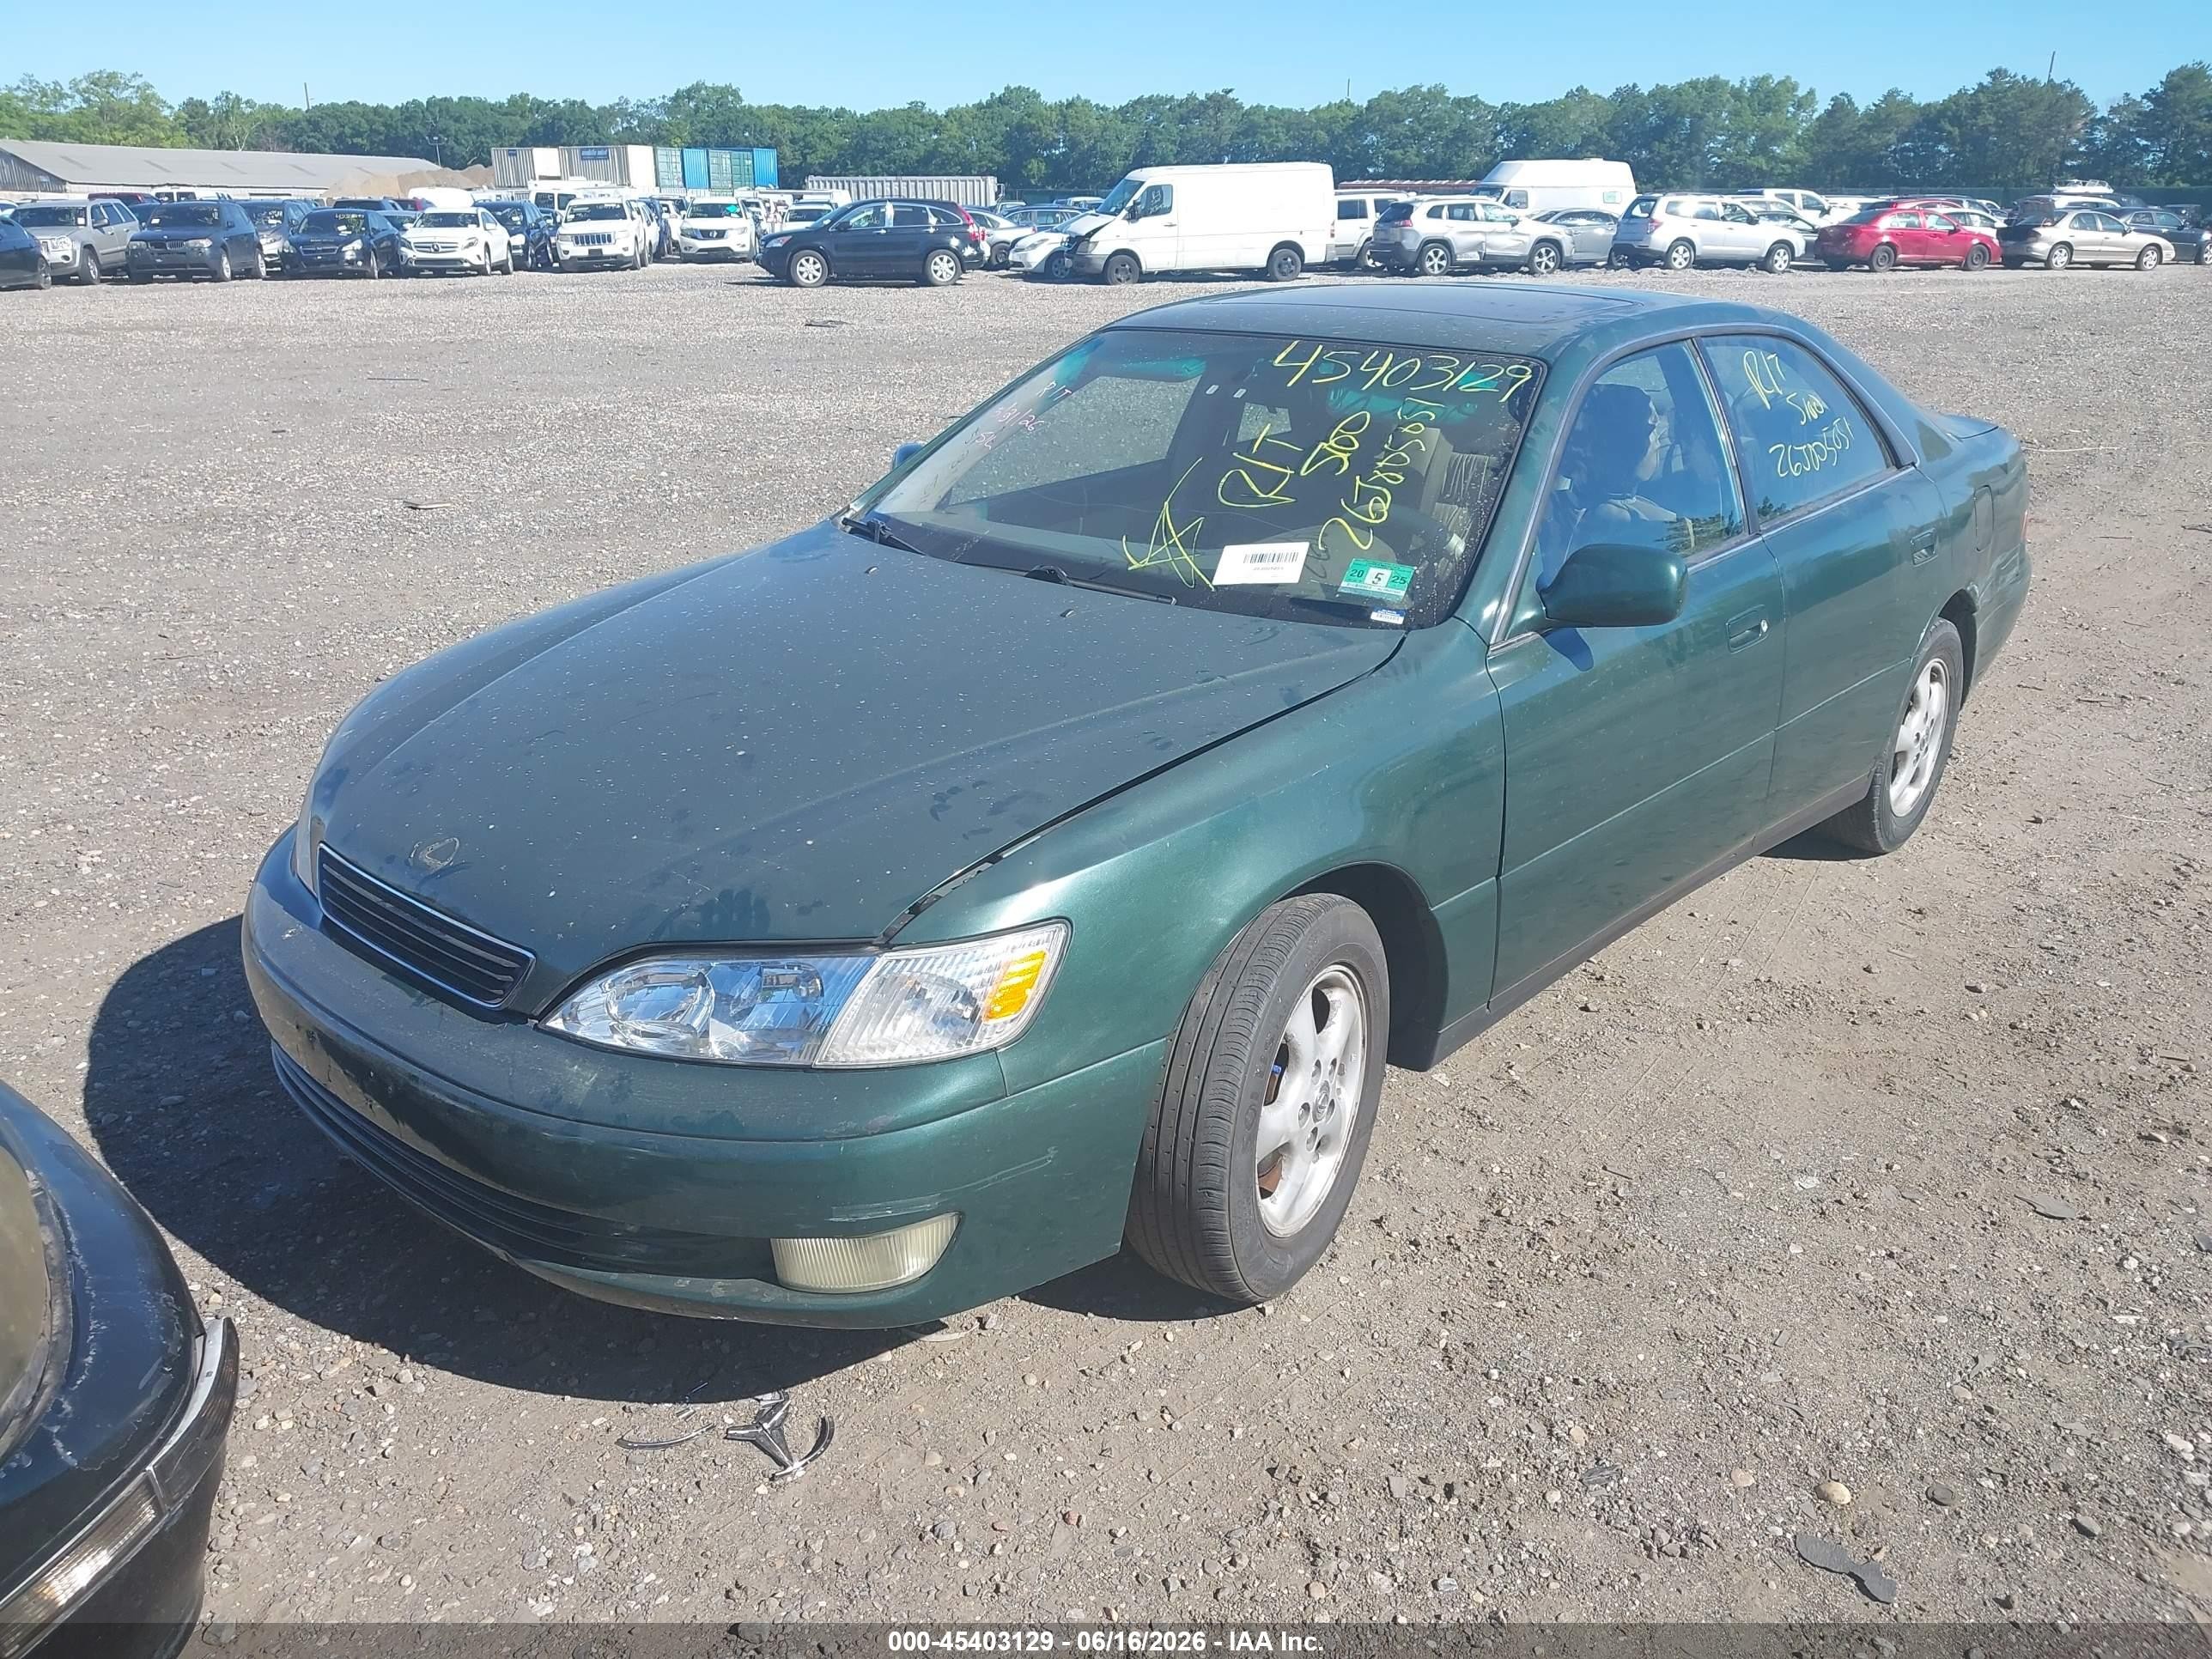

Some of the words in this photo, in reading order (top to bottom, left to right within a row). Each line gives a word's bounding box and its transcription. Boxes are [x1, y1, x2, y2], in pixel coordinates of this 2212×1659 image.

[1273, 340, 1533, 402] 45403129
[1350, 568, 1364, 578] 20
[1372, 572, 1384, 585] 5
[1391, 575, 1407, 585] 25
